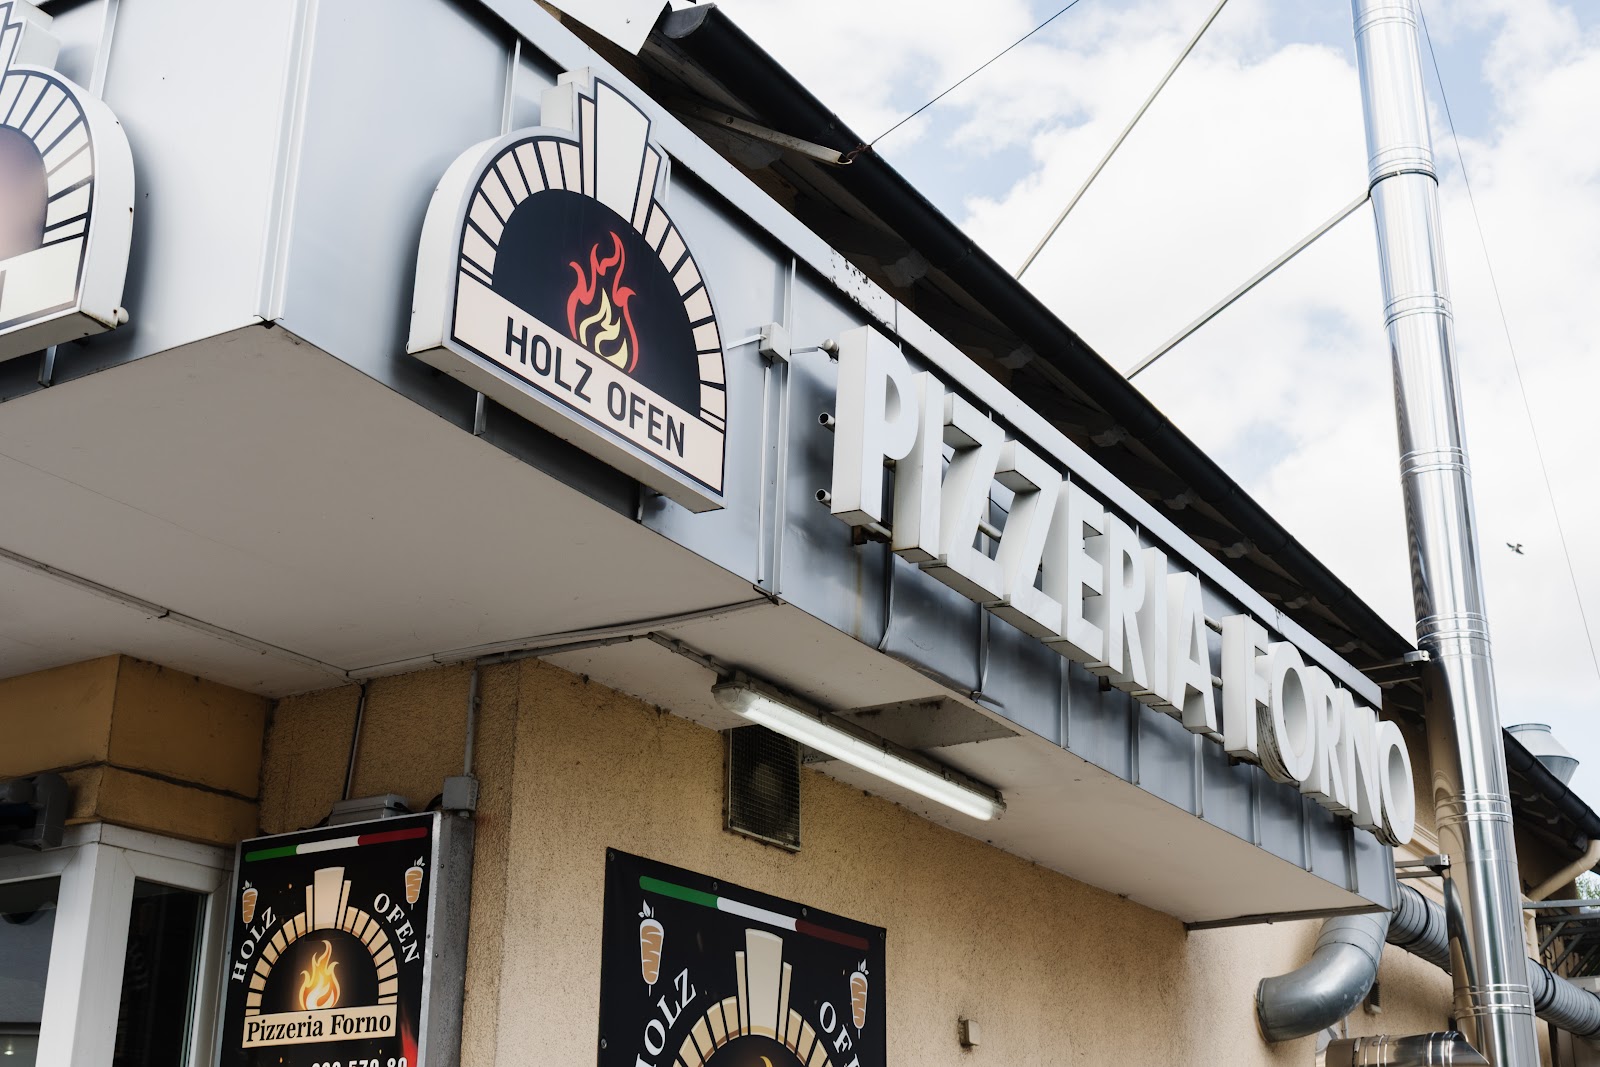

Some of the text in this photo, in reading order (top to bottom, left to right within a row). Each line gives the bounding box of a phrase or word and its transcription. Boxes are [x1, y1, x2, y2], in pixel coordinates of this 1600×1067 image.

[505, 316, 686, 459] HOLZ OFEN
[831, 325, 1416, 847] PIZZERIA FORNO
[231, 906, 278, 984] HOLZ
[373, 892, 421, 964] OFEN
[245, 1013, 392, 1043] Pizzeria Forno
